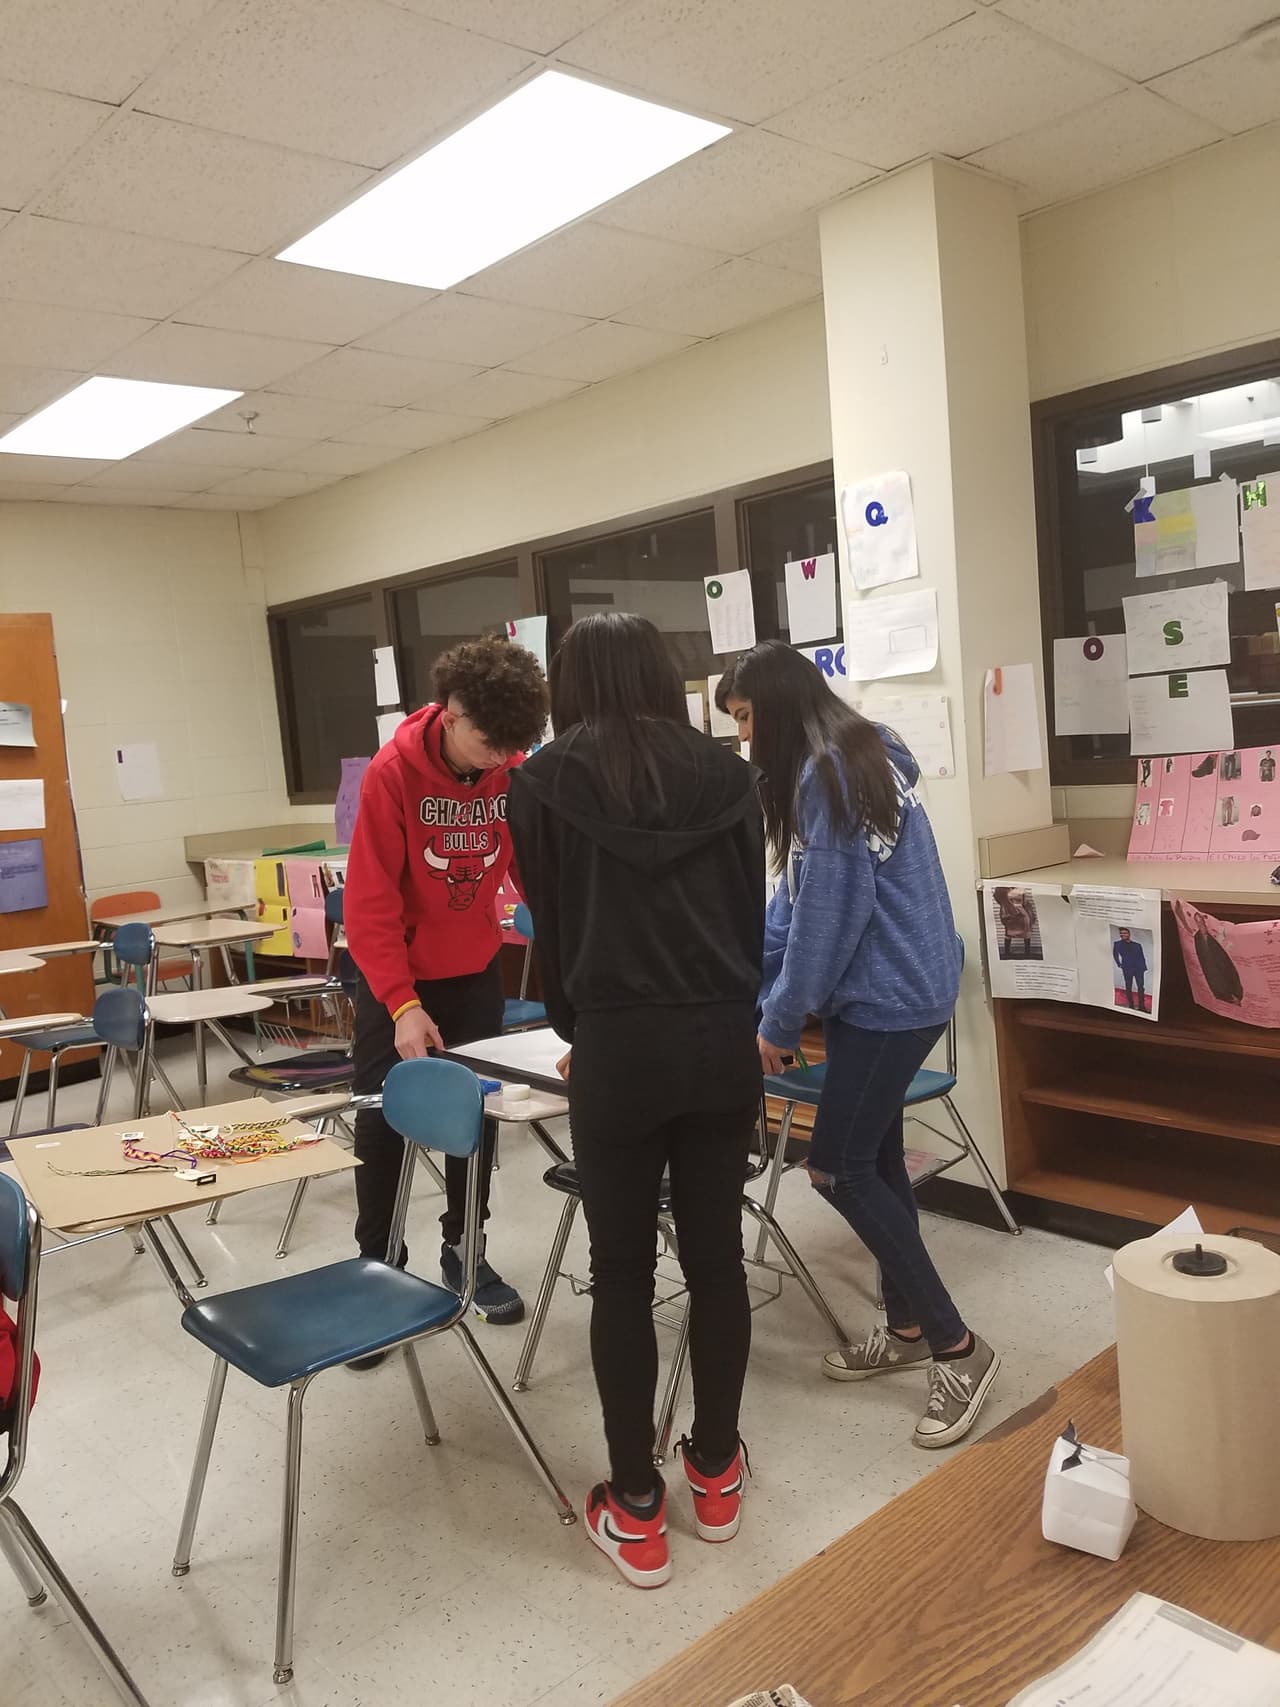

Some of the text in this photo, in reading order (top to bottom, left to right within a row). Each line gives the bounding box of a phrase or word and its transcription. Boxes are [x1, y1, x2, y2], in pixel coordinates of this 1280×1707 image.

[1242, 480, 1267, 511] H
[865, 501, 888, 526] Q
[801, 558, 817, 580] W
[1162, 620, 1184, 646] S
[1083, 637, 1104, 661] O
[1168, 674, 1189, 698] E
[443, 831, 489, 852] BULLS
